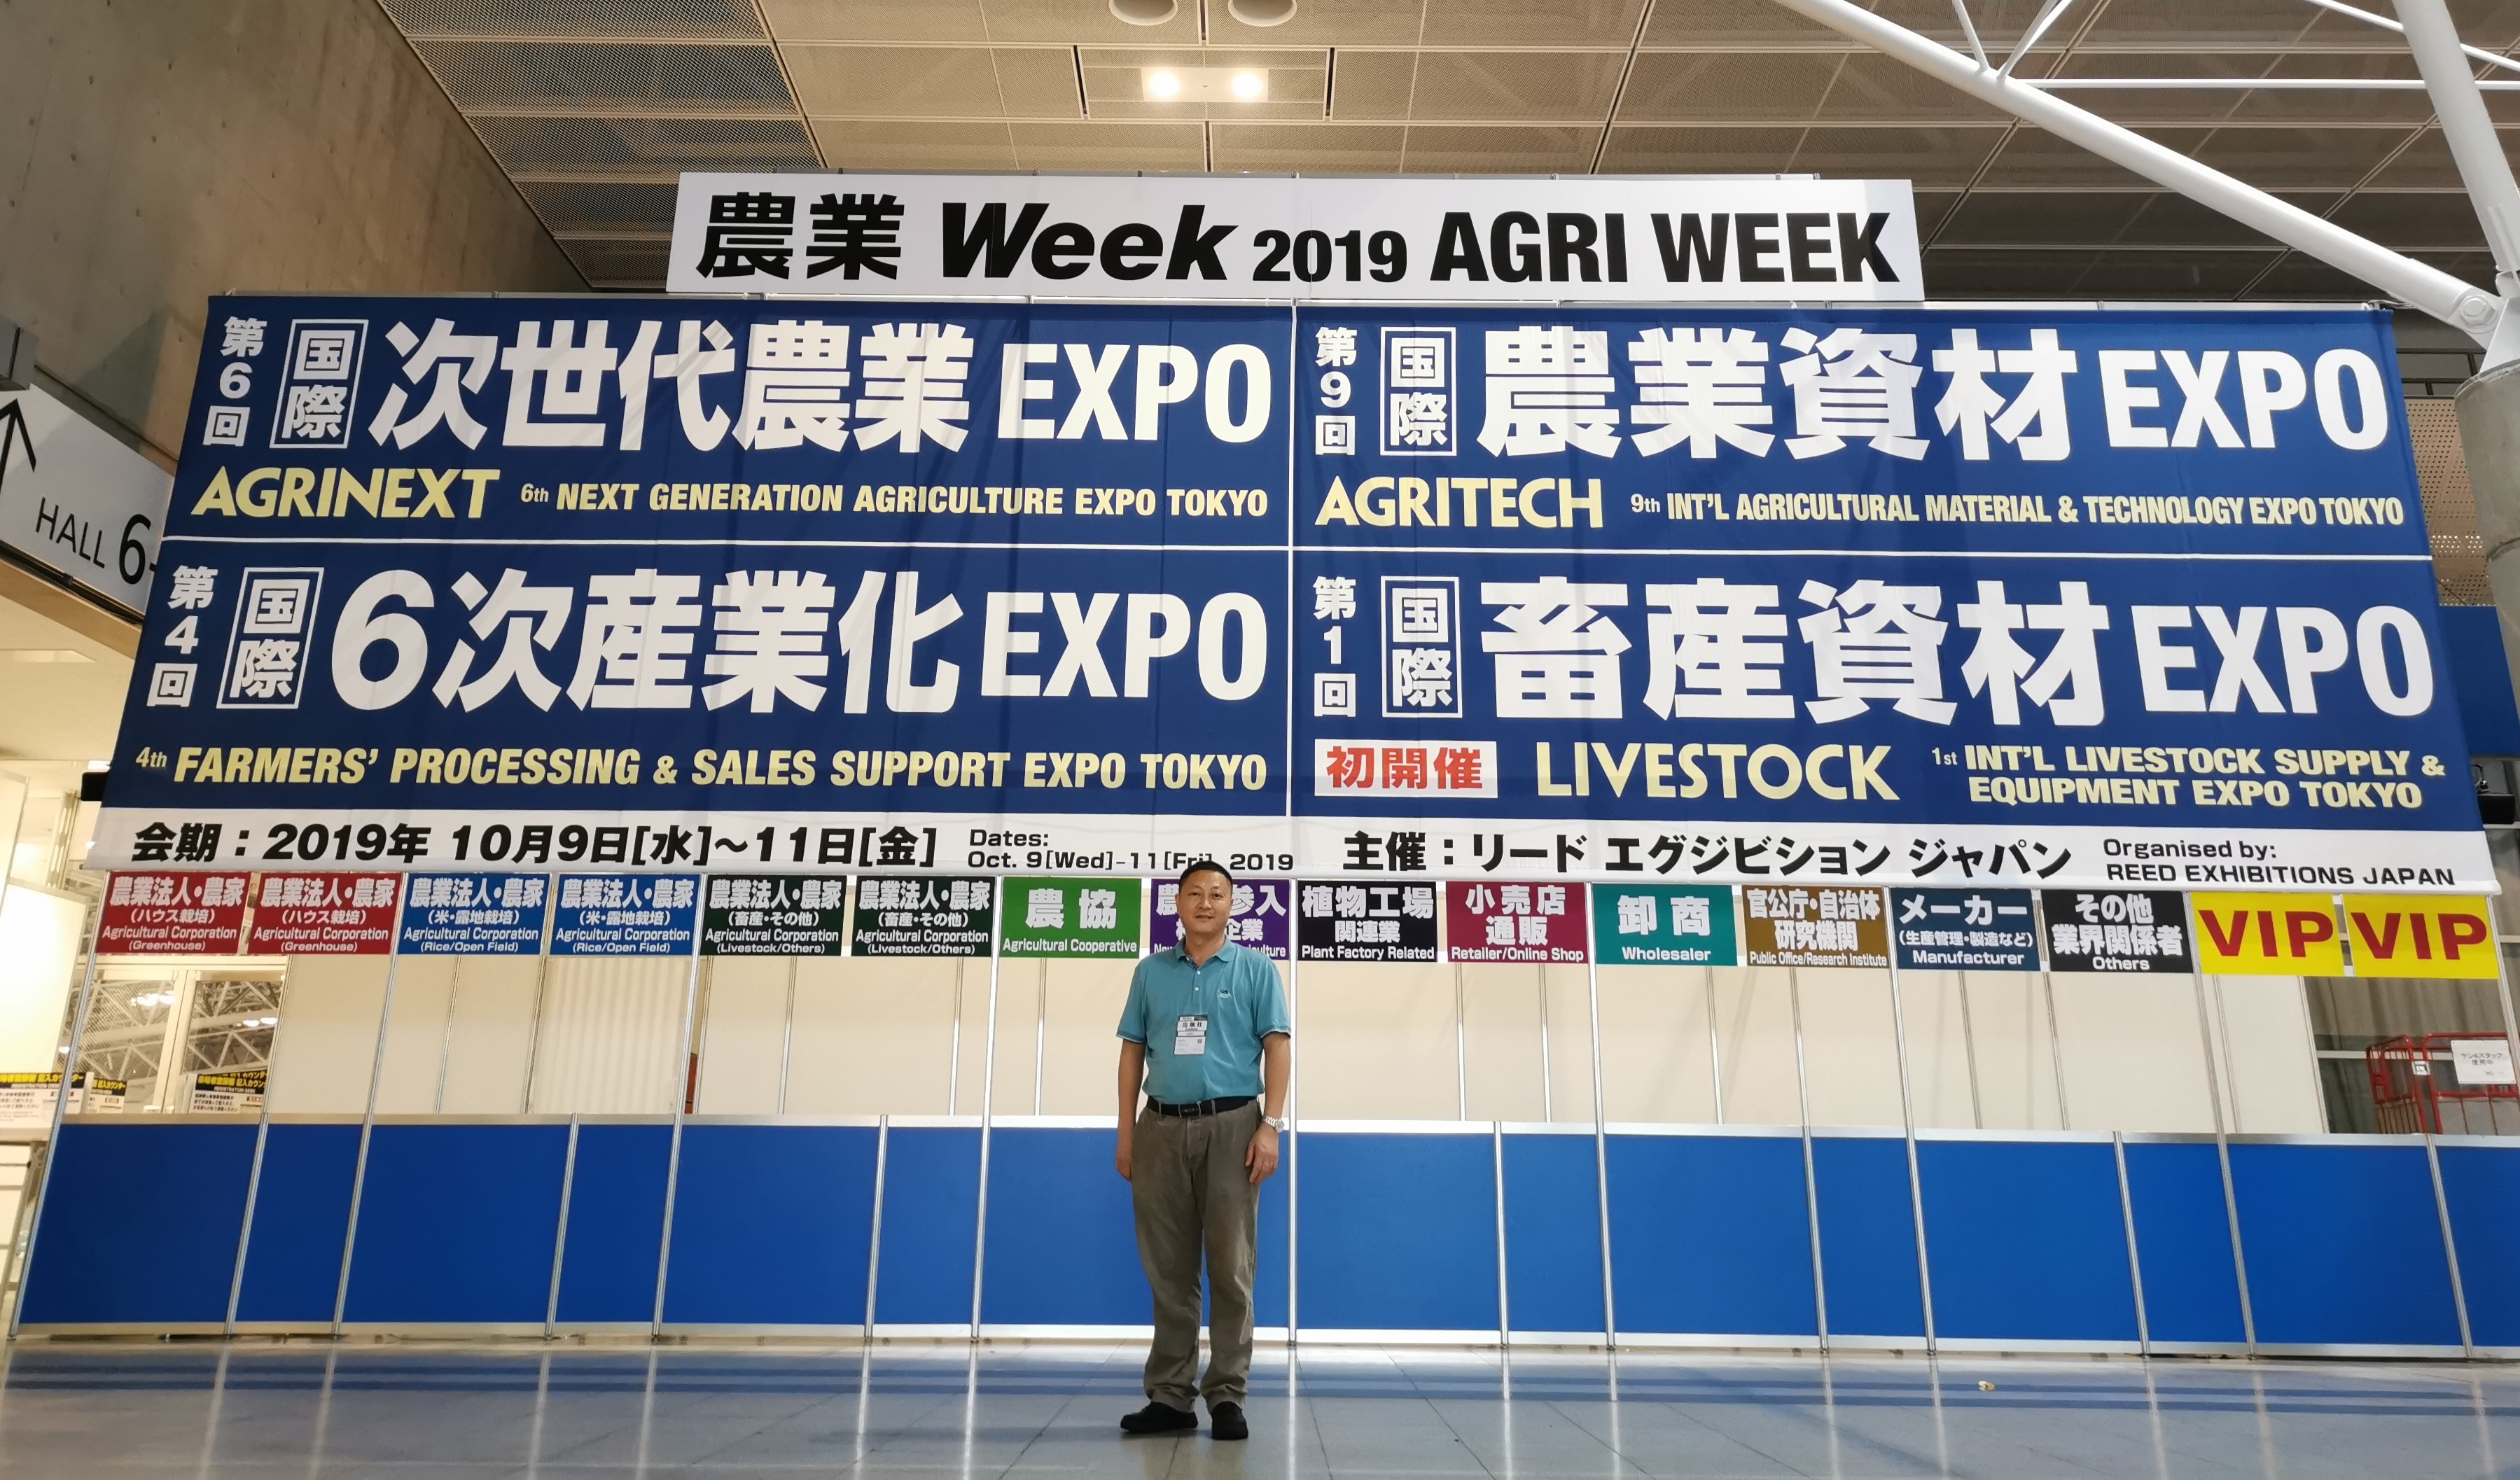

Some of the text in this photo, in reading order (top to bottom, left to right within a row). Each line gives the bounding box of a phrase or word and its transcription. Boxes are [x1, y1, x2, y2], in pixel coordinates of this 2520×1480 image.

[697, 191, 1900, 283] 農業 Week 2019 AGRI WEEK
[281, 330, 356, 440] 国際
[368, 318, 1272, 454] 次世代農業 EXPO
[1389, 337, 1449, 447] 国際
[1475, 325, 2389, 461] 農業資材 EXPO
[190, 466, 501, 519] AGRINEXT
[520, 482, 1269, 517] 6th NEXT GENERATION AGRICULTURE EXPO TOKYO
[1314, 475, 1603, 529] AGRITECH
[1631, 493, 1662, 513] 9th
[1736, 493, 1919, 522] AGRICULTURAL
[1925, 494, 2052, 523] MATERIAL
[2058, 496, 2079, 524] &
[2083, 496, 2245, 525] TECHNOLOGY
[2250, 497, 2316, 525] EXPO
[2319, 498, 2404, 526] TOKYO
[35, 496, 106, 569] HALL
[229, 578, 312, 699] 国際
[330, 566, 1268, 715] 6次産業化 EXPO
[1391, 588, 1454, 708] 国際
[1480, 575, 2435, 727] 畜産資材 EXPO
[136, 748, 168, 769] 4th
[389, 747, 640, 785] PROCESSING
[652, 754, 678, 785] &
[690, 749, 816, 786] SALES
[830, 751, 1011, 788] SUPPORT
[1023, 752, 1127, 789] EXPO
[1140, 753, 1267, 790] TOKYO
[1325, 745, 1484, 791] 初開催
[1536, 741, 1900, 802] LIVESTOCK
[1932, 747, 1958, 766] 1st
[2065, 746, 2263, 775] LIVESTOCK
[2273, 748, 2410, 776] SUPPLY
[2420, 755, 2446, 777] &
[1968, 777, 2423, 809] EQUIPMENT EXPO TOKYO
[969, 829, 1050, 847] Dates:
[2103, 838, 2278, 860] Organised by:
[967, 851, 1017, 868] Oct.
[1230, 853, 1294, 871] 2019
[1606, 834, 1891, 877] エグジビション
[1908, 837, 2072, 879] ジャパン
[2106, 863, 2456, 886] REED EXHIBITIONS JAPAN
[109, 876, 246, 908] 農業法人・農家
[260, 877, 396, 909] 農業法人・農家
[409, 878, 545, 909] 農業法人・農家
[560, 878, 695, 909] 農業法人・農家
[709, 879, 842, 910] 農業法人・農家
[858, 880, 991, 911] 農業法人・農家
[1302, 885, 1434, 919] 植物工場
[1465, 884, 1566, 916] 小売店
[1746, 888, 1881, 921] 官公庁・自治体
[1025, 888, 1118, 930] 農協
[1617, 895, 1711, 936] 卸商
[1898, 894, 2028, 926] メーカー
[2075, 893, 2154, 924] その他
[102, 925, 237, 941] Agricultural Corporation
[129, 941, 206, 951] (Greenhouse)
[253, 926, 389, 941] Agricultural Corporation
[403, 926, 539, 942] Agricultural Corporation
[555, 927, 690, 942] Agricultural Corporation
[705, 928, 839, 943] Agricultural Corporation
[856, 928, 989, 943] Agricultural Corporation
[1003, 937, 1137, 953] Agricultural Cooperative
[1334, 920, 1400, 943] 関連業
[1485, 916, 1549, 946] 通販
[1774, 920, 1859, 951] 研究機関
[2051, 923, 2183, 956] 業界関係者
[2197, 910, 2334, 958] VIP
[2350, 912, 2488, 960] VIP
[280, 942, 358, 953] (Greenhouse)
[420, 942, 519, 953] (Rice/Open Field)
[572, 942, 671, 954] (Rice/Open Field)
[716, 942, 826, 954] (Livestock/Others)
[867, 944, 975, 955] (Livestock/Others)
[1302, 945, 1435, 961] Plant Factory Related
[1452, 946, 1584, 962] Retailer/Online Shop
[1622, 947, 1711, 961] Wholesaler
[1750, 951, 1888, 967] Public Office/Research Institute
[1912, 949, 2025, 965] Manufacturer
[2092, 956, 2150, 971] Others
